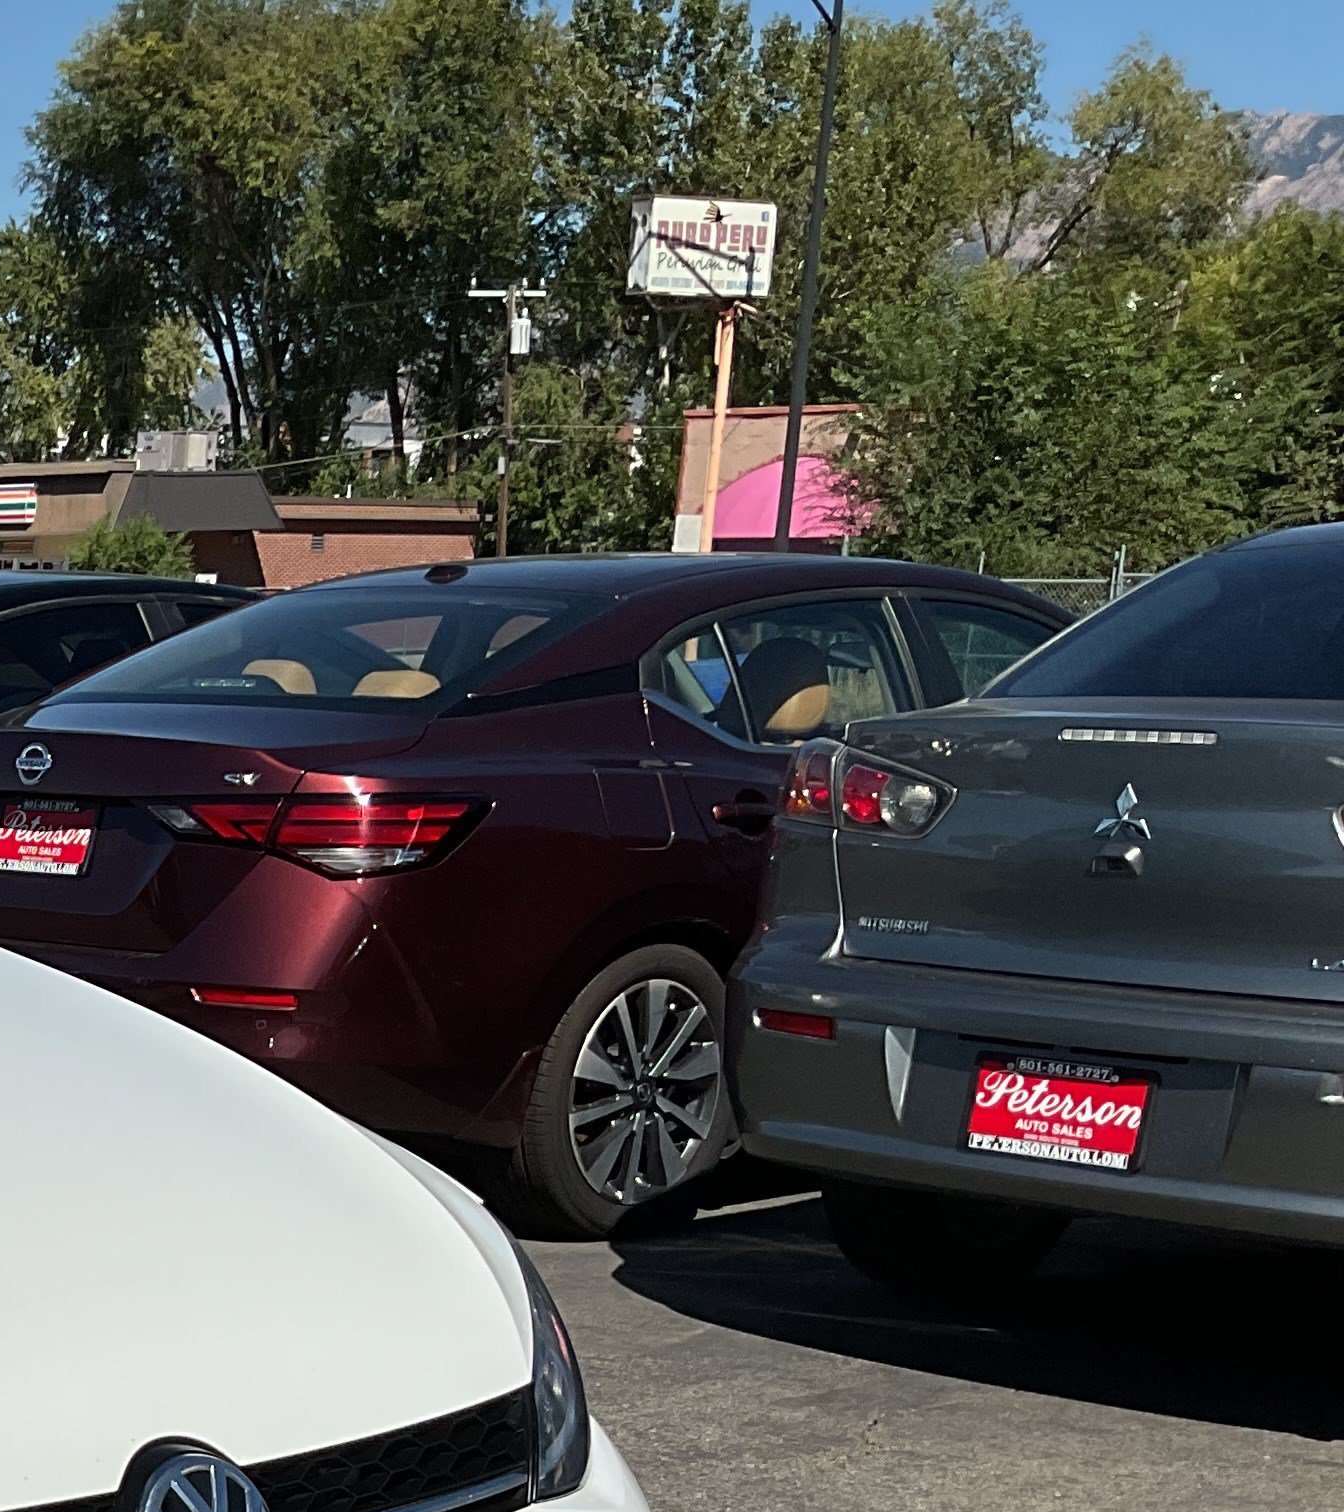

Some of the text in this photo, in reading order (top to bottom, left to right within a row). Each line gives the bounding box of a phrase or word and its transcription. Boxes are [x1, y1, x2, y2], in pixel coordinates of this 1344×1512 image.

[1018, 1058, 1110, 1081] 801-561-2727
[975, 1070, 1143, 1129] Peterson
[1015, 1118, 1049, 1133] AUTO
[1052, 1122, 1093, 1140] SALES
